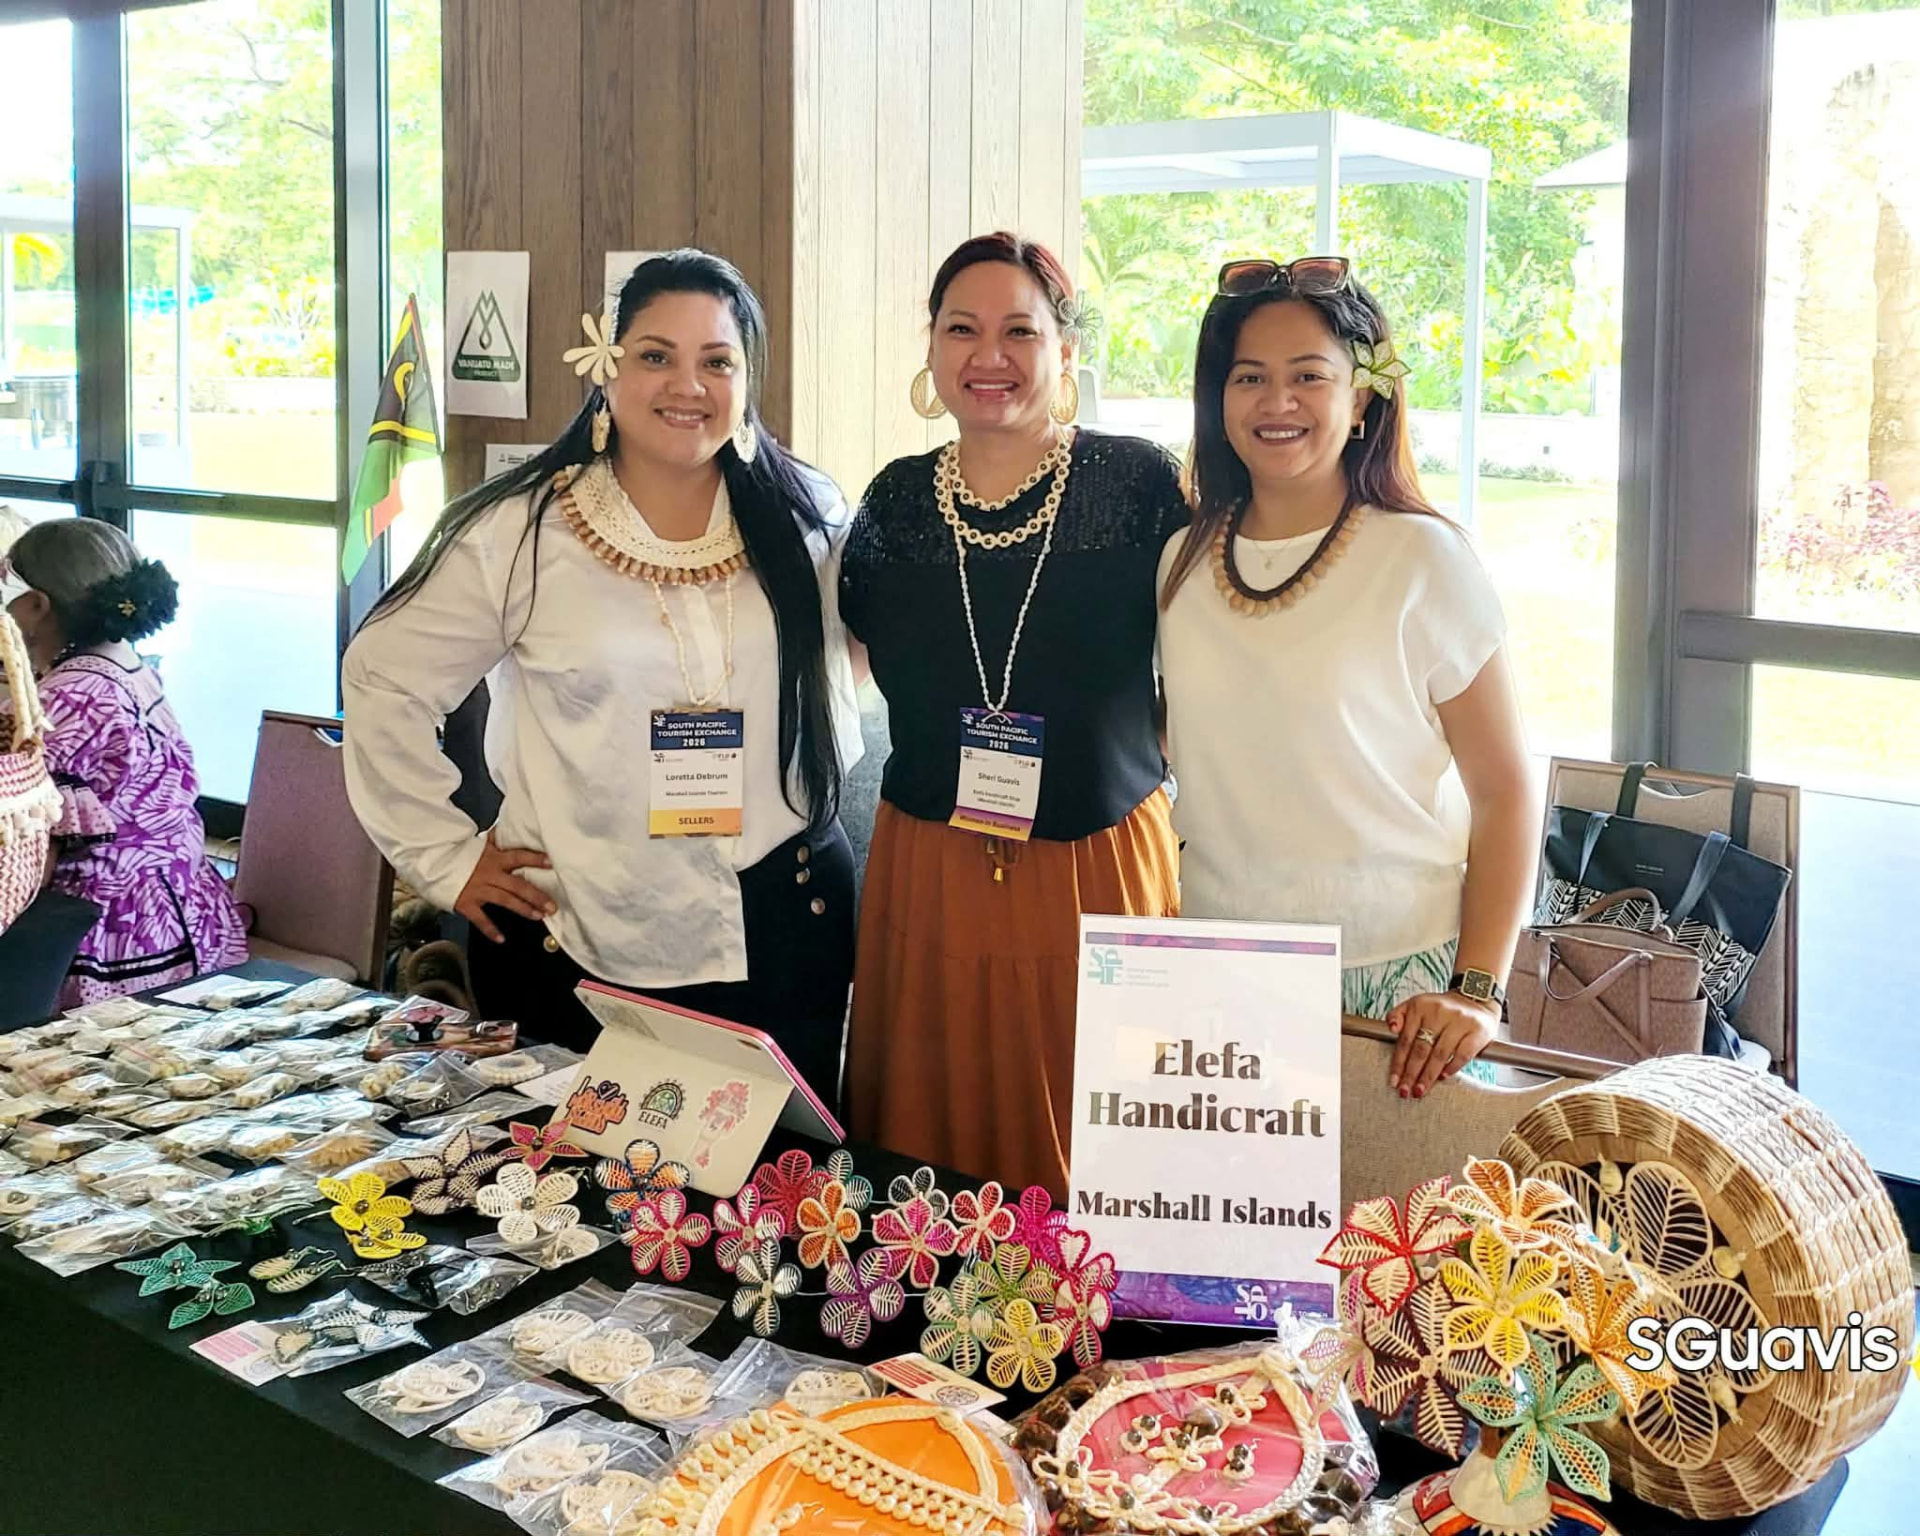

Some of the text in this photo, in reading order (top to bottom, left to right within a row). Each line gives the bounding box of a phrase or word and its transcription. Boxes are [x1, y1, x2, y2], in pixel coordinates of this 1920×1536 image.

[458, 359, 515, 370] VANUATU MADE
[694, 728, 737, 736] EXCHANGE
[975, 722, 1029, 735] SOUTH PACIFIC
[682, 738, 706, 746] 2026
[967, 728, 1038, 744] TOURISM EXCHANGE
[665, 773, 695, 781] Loretta
[978, 772, 1020, 786] Sheri Guavis
[678, 816, 714, 825] SELLERS
[1152, 1039, 1261, 1080] Elefa
[638, 1111, 668, 1130] ELEFA
[1088, 1091, 1327, 1138] Handicraft
[1076, 1190, 1333, 1230] Marshall Islands
